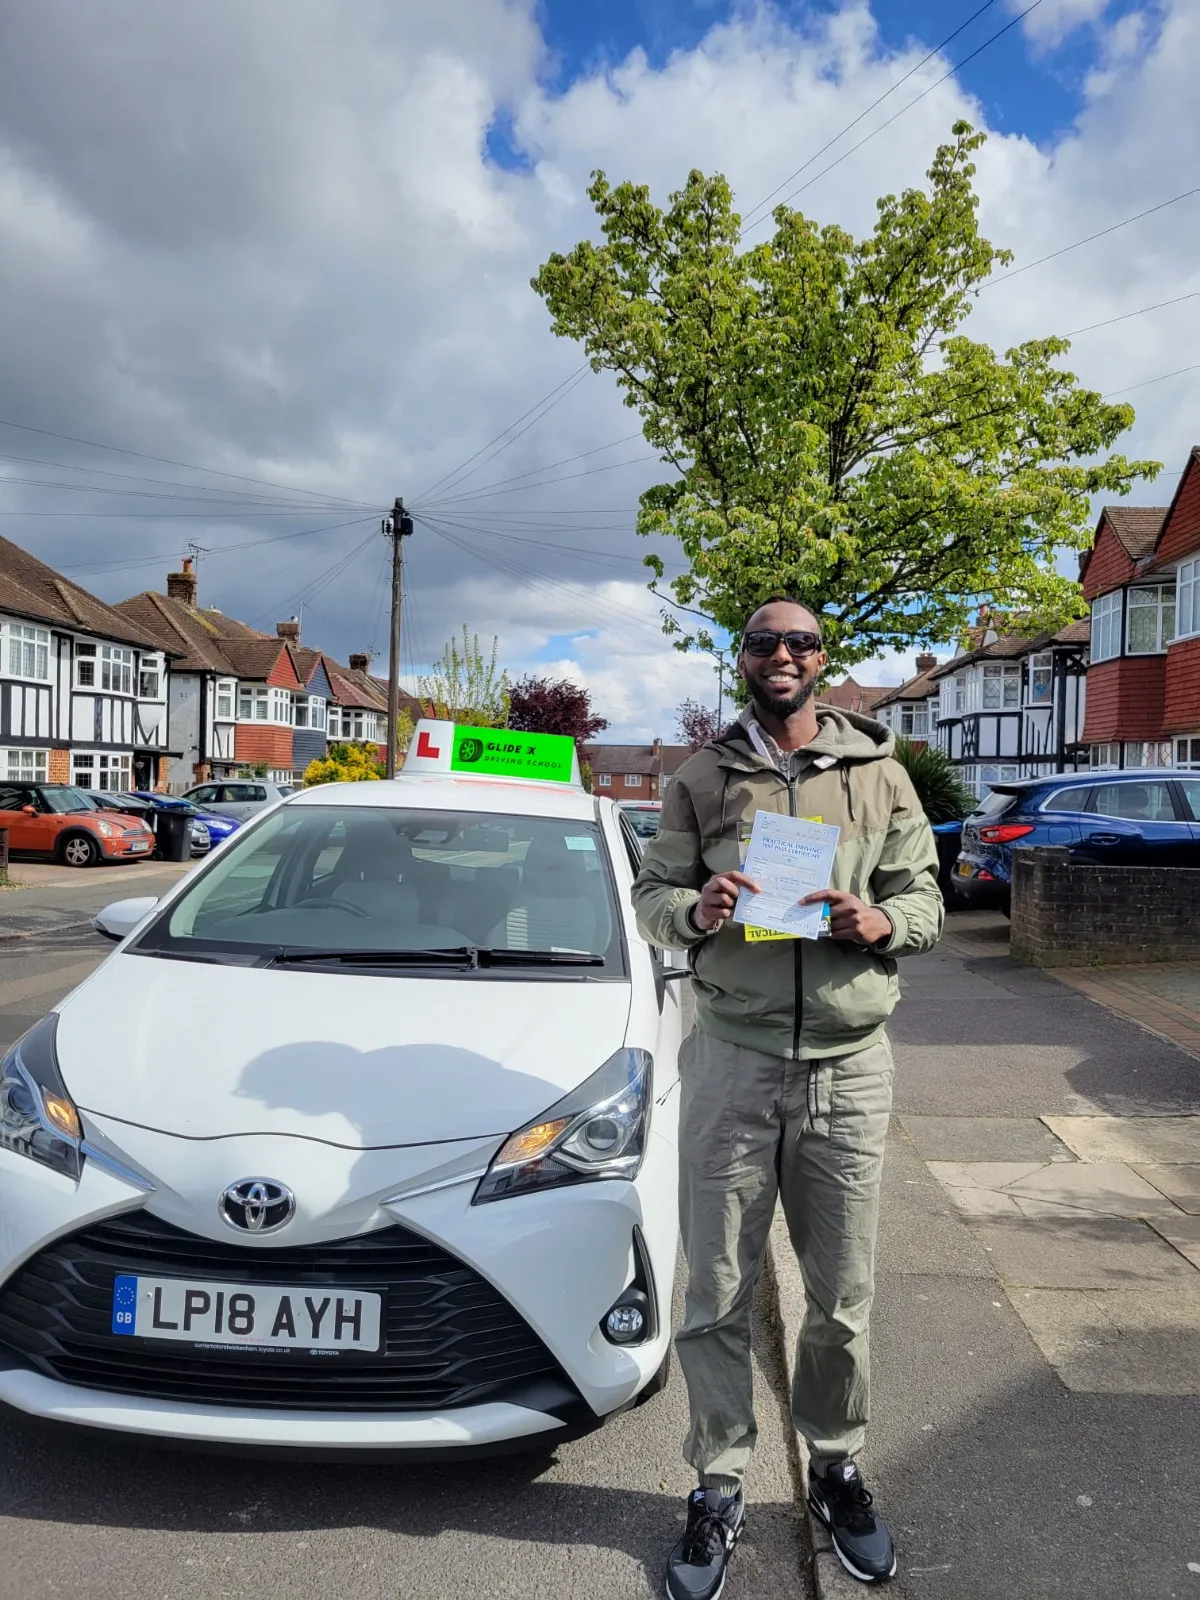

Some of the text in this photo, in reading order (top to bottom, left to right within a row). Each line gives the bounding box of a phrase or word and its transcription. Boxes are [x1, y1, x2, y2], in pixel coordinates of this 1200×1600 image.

[417, 732, 440, 758] L
[486, 742, 537, 755] GLIDE X
[484, 755, 563, 769] DRIVING SCHOOL
[762, 836, 822, 854] PRACTICAL DRIVING
[762, 842, 774, 850] TEST
[787, 849, 820, 860] CERTIFICATE
[116, 1312, 132, 1324] GB
[152, 1286, 363, 1341] LP18 AYH
